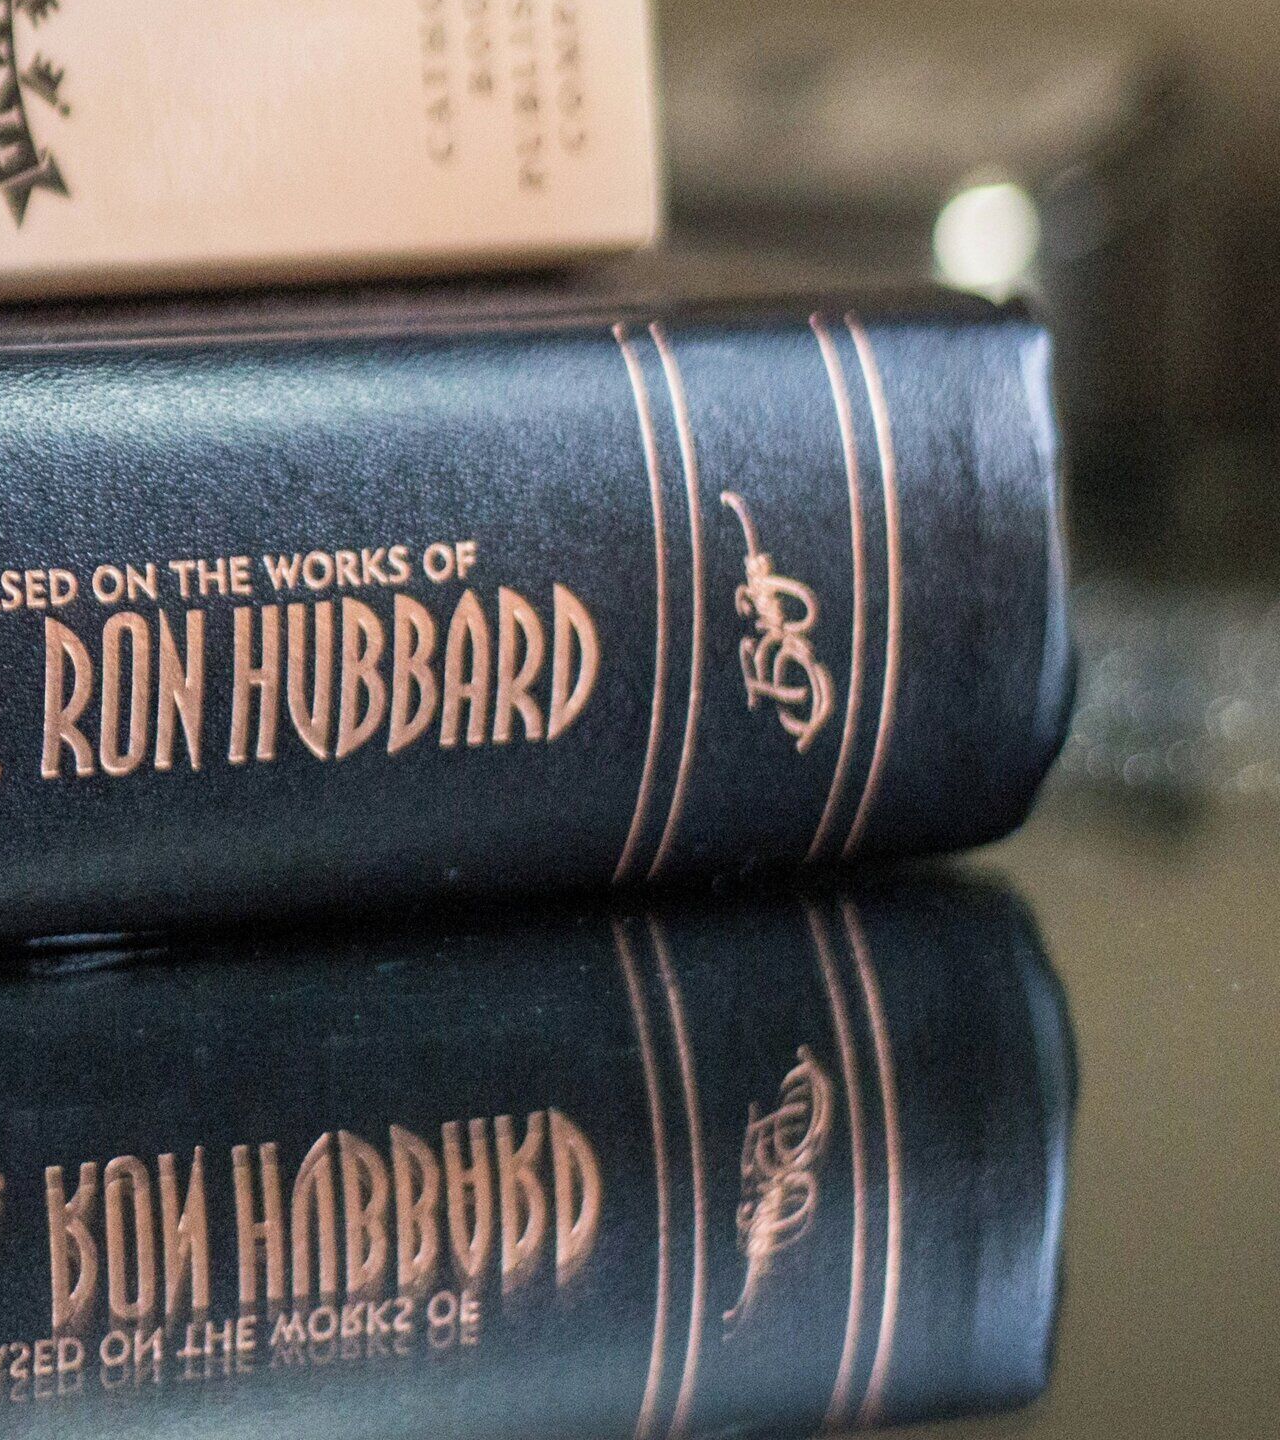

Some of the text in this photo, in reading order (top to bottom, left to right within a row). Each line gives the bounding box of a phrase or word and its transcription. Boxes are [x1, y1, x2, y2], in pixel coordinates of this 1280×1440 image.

[91, 563, 158, 605] ON
[167, 556, 250, 600] THE
[262, 544, 411, 592] WORKS
[422, 539, 478, 581] OF
[42, 608, 206, 779] RON
[227, 583, 601, 763] HUBBARD
